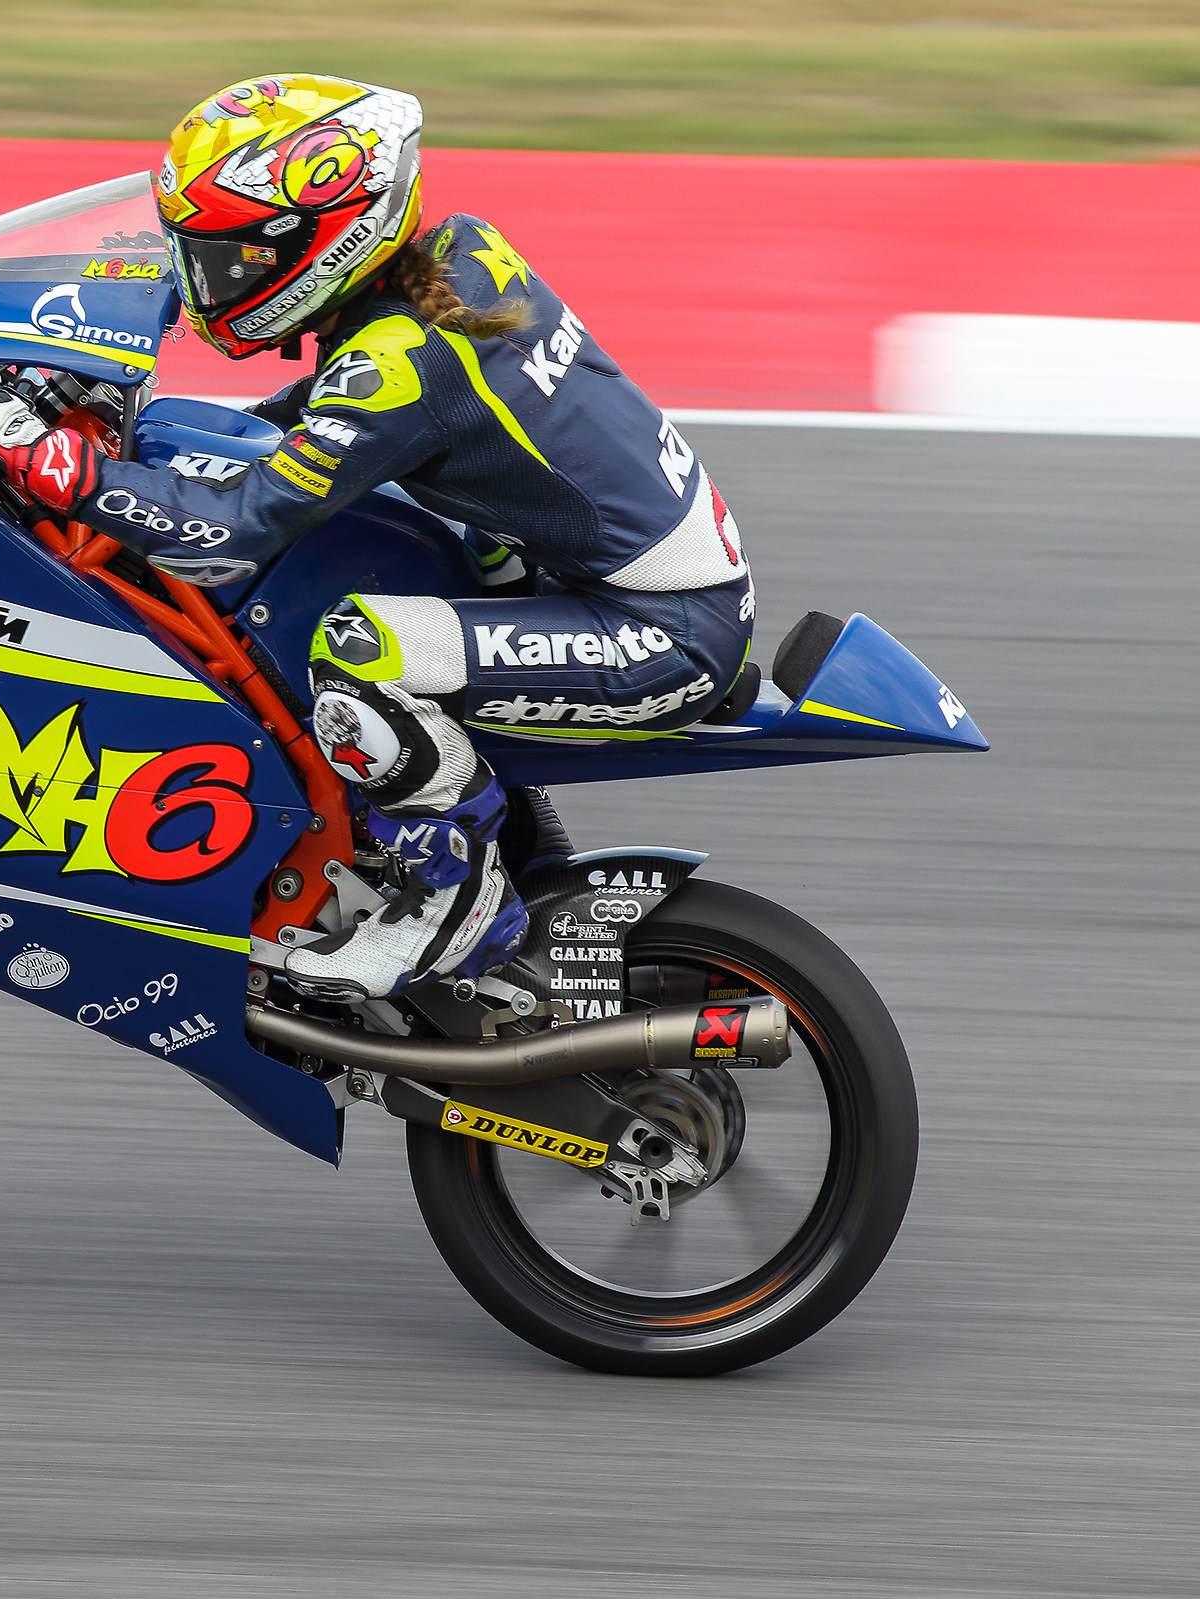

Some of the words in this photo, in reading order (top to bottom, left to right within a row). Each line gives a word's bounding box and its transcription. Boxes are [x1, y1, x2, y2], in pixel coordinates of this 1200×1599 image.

[321, 222, 373, 272] SHOEI
[240, 279, 318, 332] KARENTO
[38, 313, 153, 350] Simon
[302, 414, 359, 447] KTM
[279, 459, 328, 490] DUNLOP
[96, 489, 175, 532] Ocio
[178, 519, 232, 549] 99
[473, 622, 674, 669] Karento
[475, 672, 716, 726] alpinestars
[588, 869, 667, 889] GALL
[566, 925, 605, 933] SPRINT
[577, 931, 615, 939] FILTER
[550, 947, 624, 962] GALFER
[550, 968, 621, 990] domino
[77, 996, 140, 1027] Ocio
[144, 973, 179, 1004] 99
[149, 1013, 216, 1048] GALL
[163, 1028, 218, 1056] pintures
[468, 1115, 605, 1164] DUNLOP
